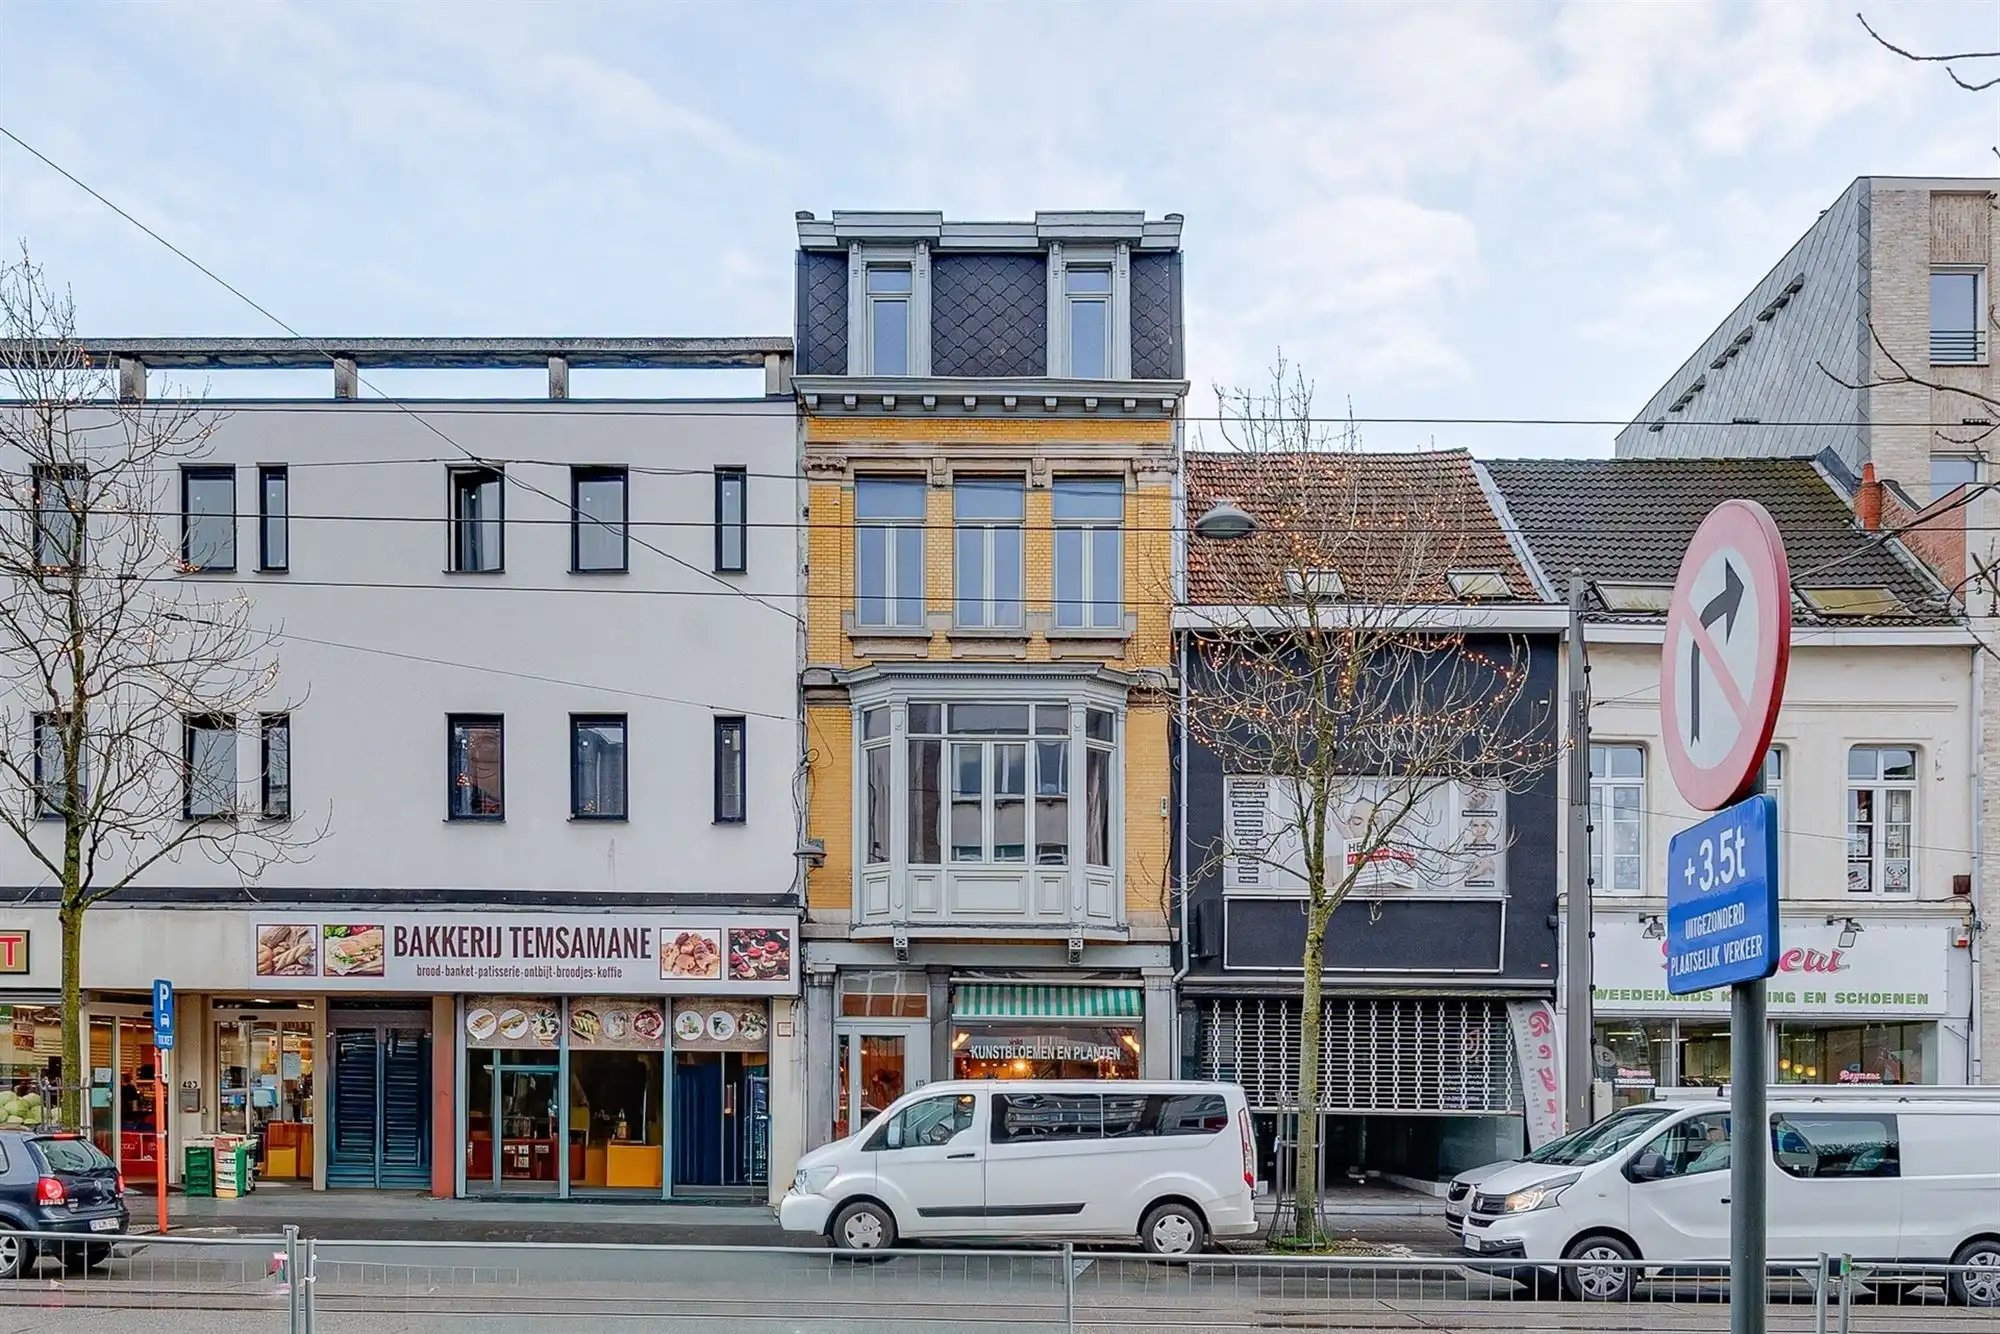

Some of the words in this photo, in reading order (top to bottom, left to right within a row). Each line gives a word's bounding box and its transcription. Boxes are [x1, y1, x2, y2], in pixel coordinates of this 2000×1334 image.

[1685, 902, 1745, 940] UITGEZONDERD
[393, 925, 502, 959] BAKKERIJ
[508, 926, 652, 959] TEMSAMANE
[1671, 945, 1720, 977] PLAATSELIJK
[1723, 934, 1763, 964] VERKEER
[1594, 988, 1713, 1002] WEEDEHANDS
[1804, 991, 1826, 1003] EN
[1834, 992, 1929, 1005] SCHOENEN
[971, 1045, 1055, 1060] KUNSTBLOEMEN
[1057, 1046, 1071, 1060] EN
[1073, 1046, 1121, 1060] PLANTEN
